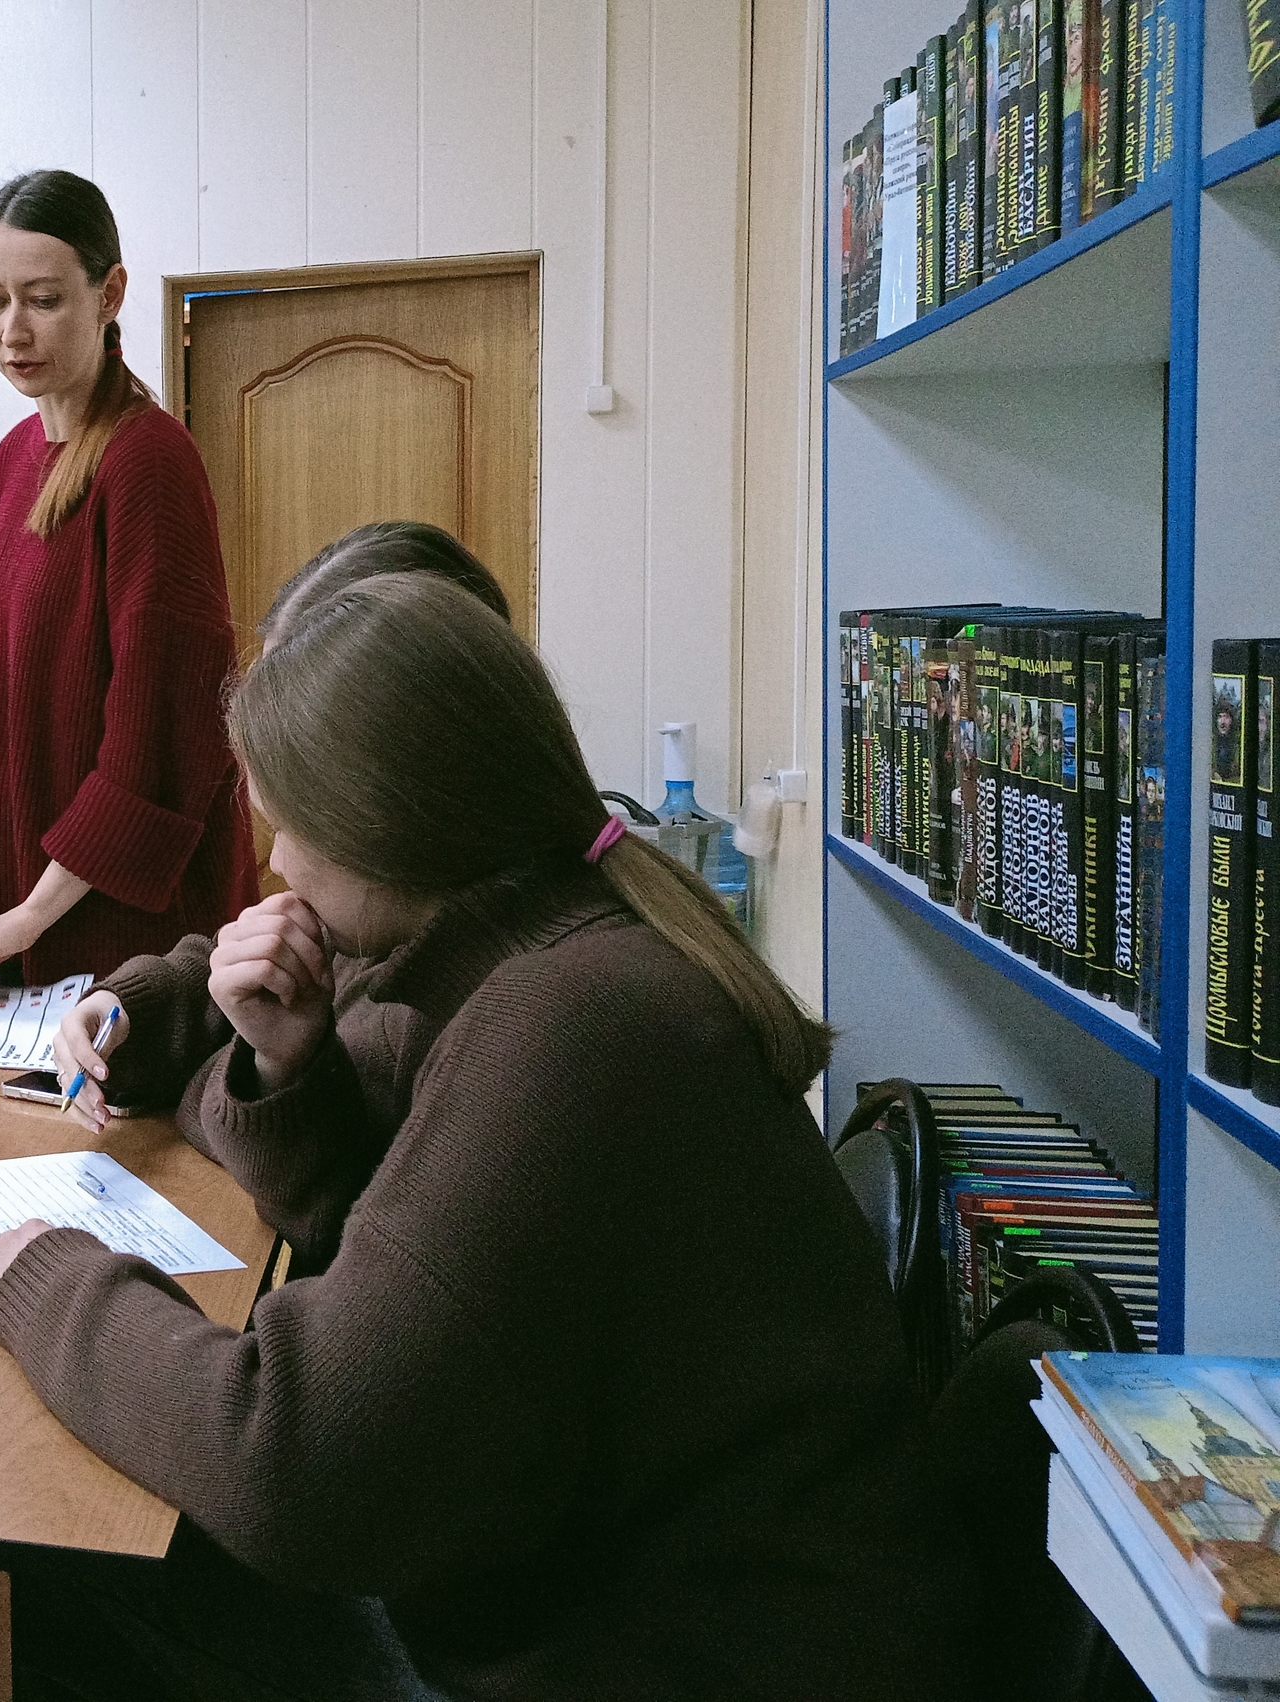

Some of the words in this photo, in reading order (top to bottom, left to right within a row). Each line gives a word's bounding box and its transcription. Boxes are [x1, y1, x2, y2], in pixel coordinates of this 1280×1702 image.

[996, 116, 1008, 250] Забайкальцы
[1008, 105, 1020, 242] Забайкальцы
[1023, 113, 1035, 235] БАСАРГИН
[1038, 91, 1048, 155] пчелы
[1095, 87, 1111, 190] Русский
[1125, 122, 1138, 174] Люди
[1036, 165, 1051, 226] Дикие
[985, 778, 999, 903] ЗАДОРНОВ
[1011, 788, 1021, 918] ЗАДОРНОВ
[1026, 794, 1039, 927] ЗАДОРНОВ
[1039, 799, 1051, 935] ЗАДОРНОВ
[1119, 813, 1132, 970] ЗИГАНШИН
[1212, 835, 1231, 888] были
[1068, 873, 1077, 949] ЗЯБРЕВ
[1206, 896, 1238, 1038] Промысловые
